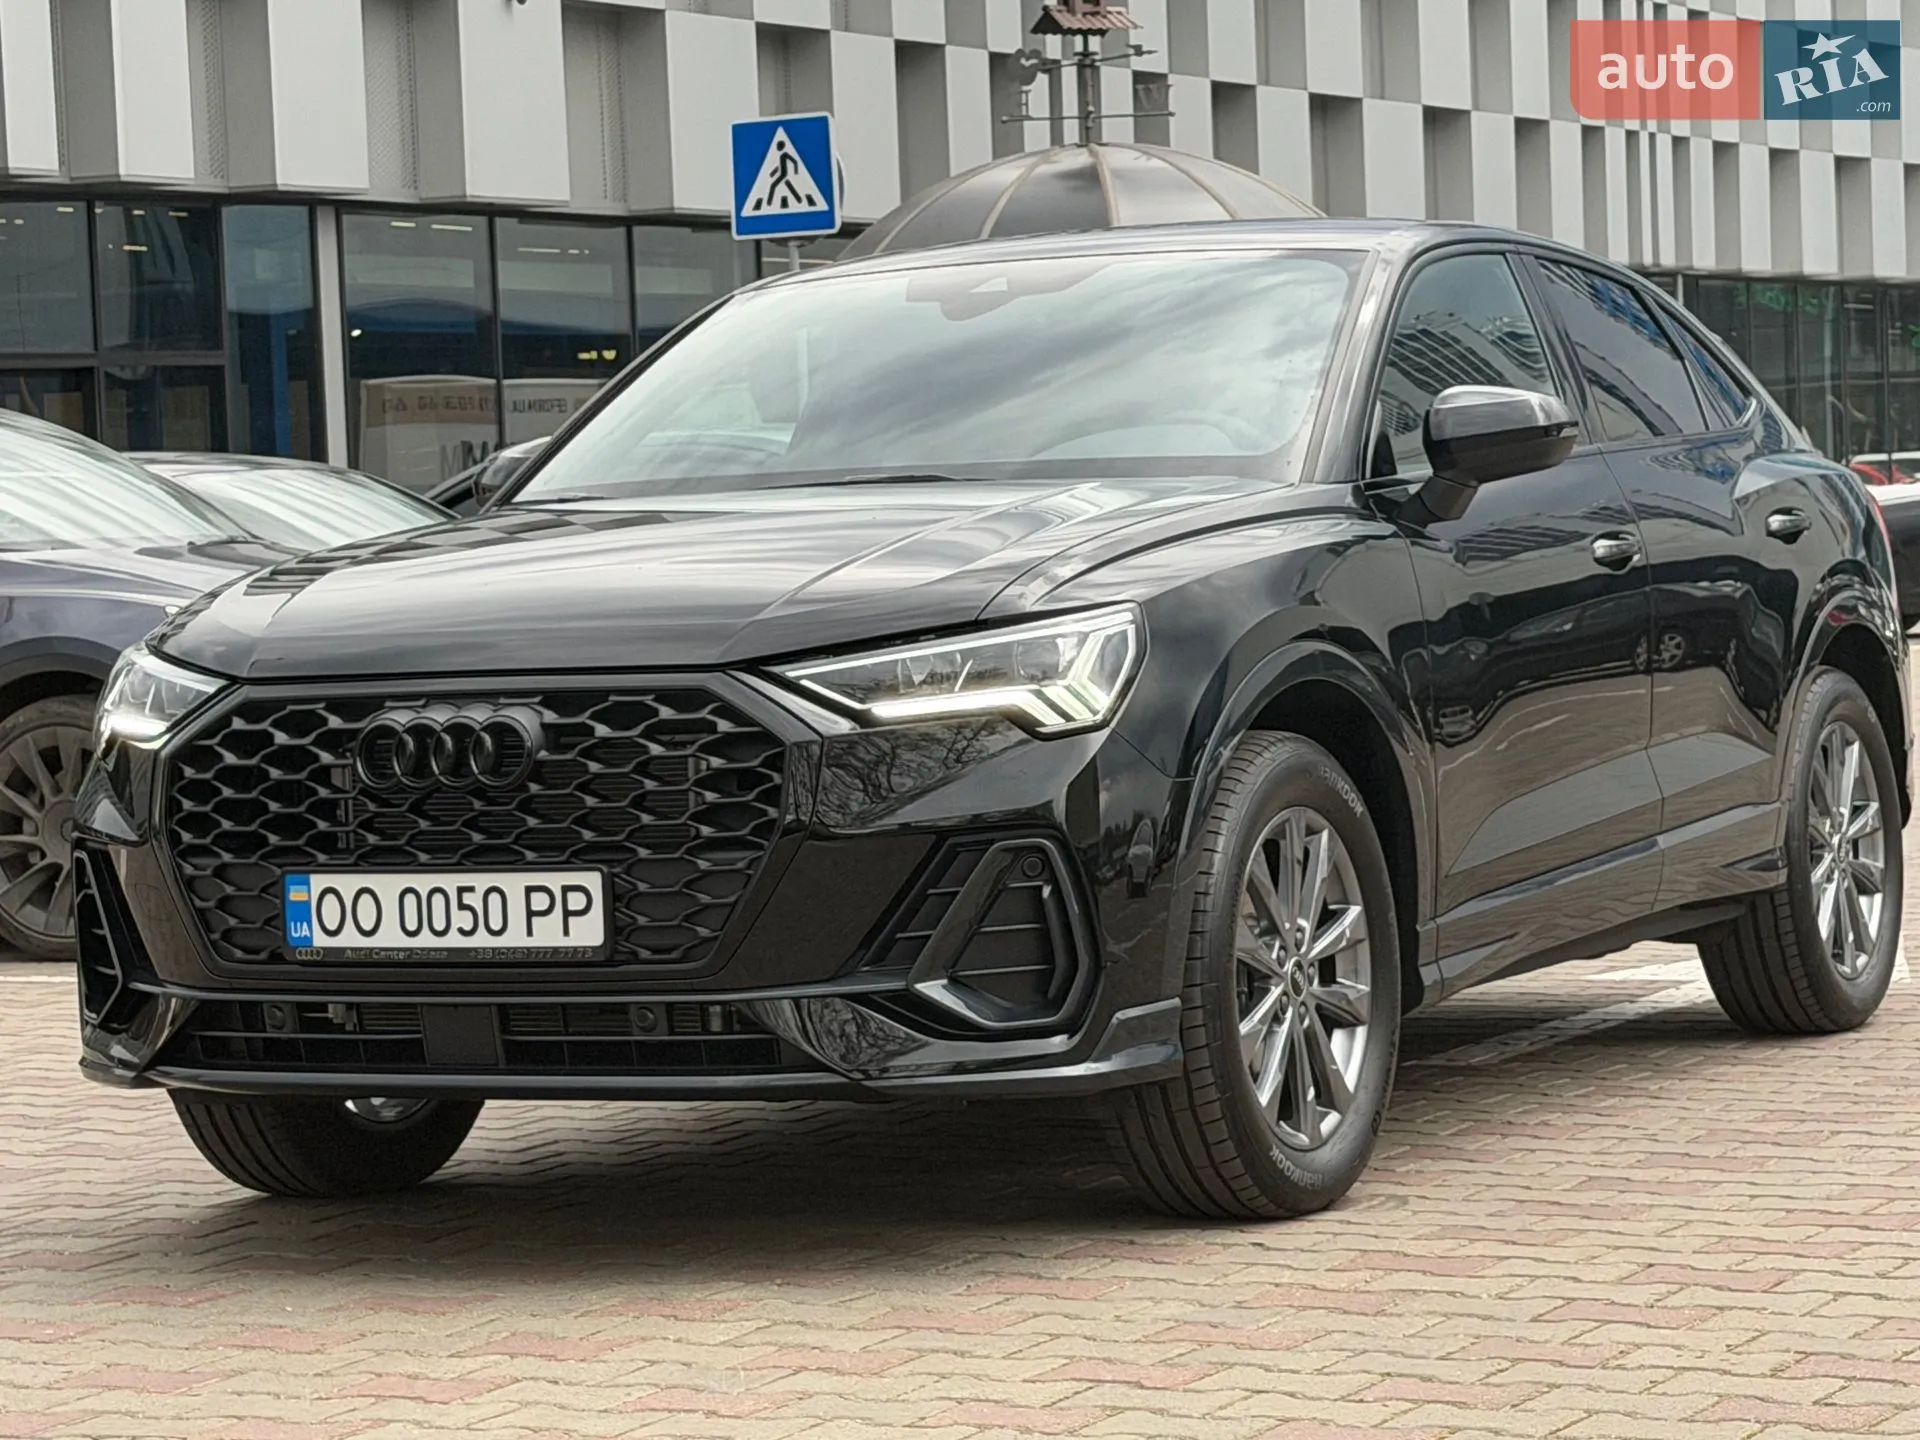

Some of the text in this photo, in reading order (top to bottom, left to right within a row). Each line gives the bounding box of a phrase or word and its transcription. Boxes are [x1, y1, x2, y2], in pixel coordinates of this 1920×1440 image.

[315, 884, 594, 938] OO 0050 PP
[290, 922, 311, 937] UA
